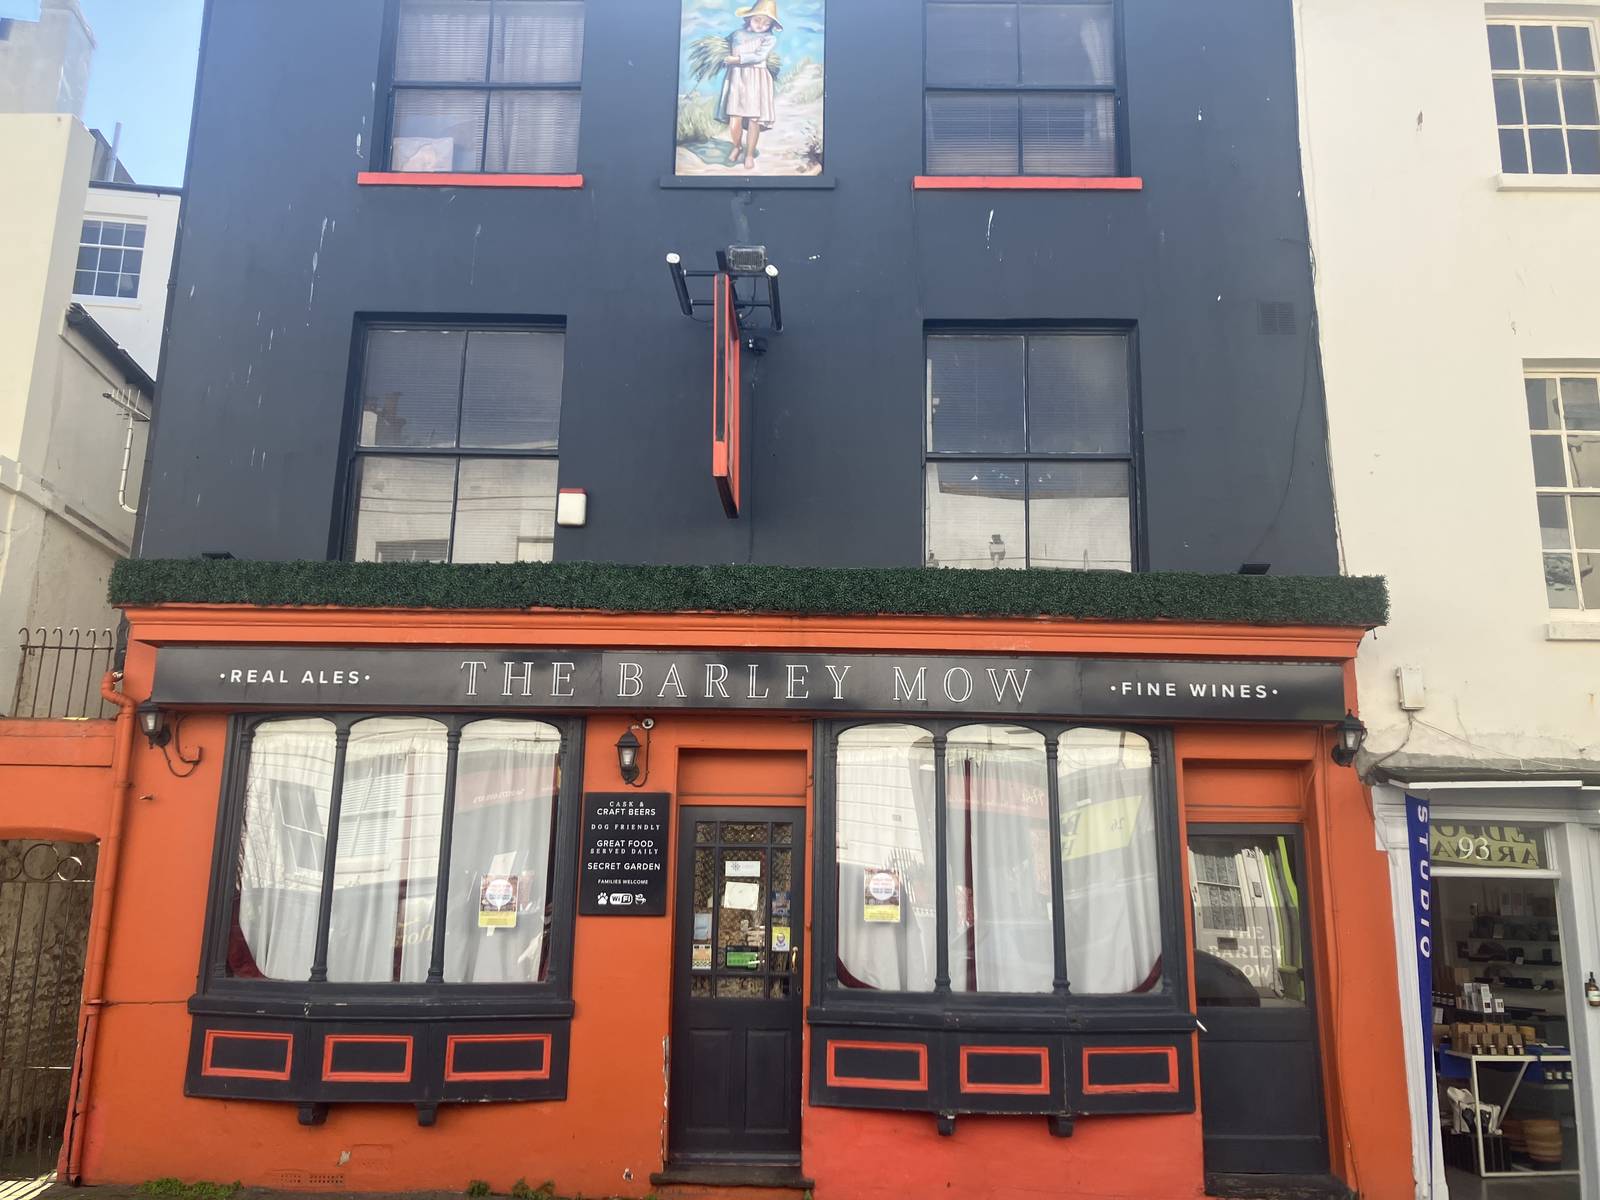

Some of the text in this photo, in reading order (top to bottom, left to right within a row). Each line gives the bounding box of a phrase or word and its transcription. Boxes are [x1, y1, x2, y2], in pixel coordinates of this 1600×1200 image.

[460, 661, 1032, 703] THE BARLEY MOW
[596, 808, 656, 816] CRAFT BEERS
[596, 839, 654, 848] GREAT FOOD
[1457, 836, 1490, 860] 93
[587, 862, 661, 871] SECRET GARDEN
[1417, 805, 1431, 959] STUDIO
